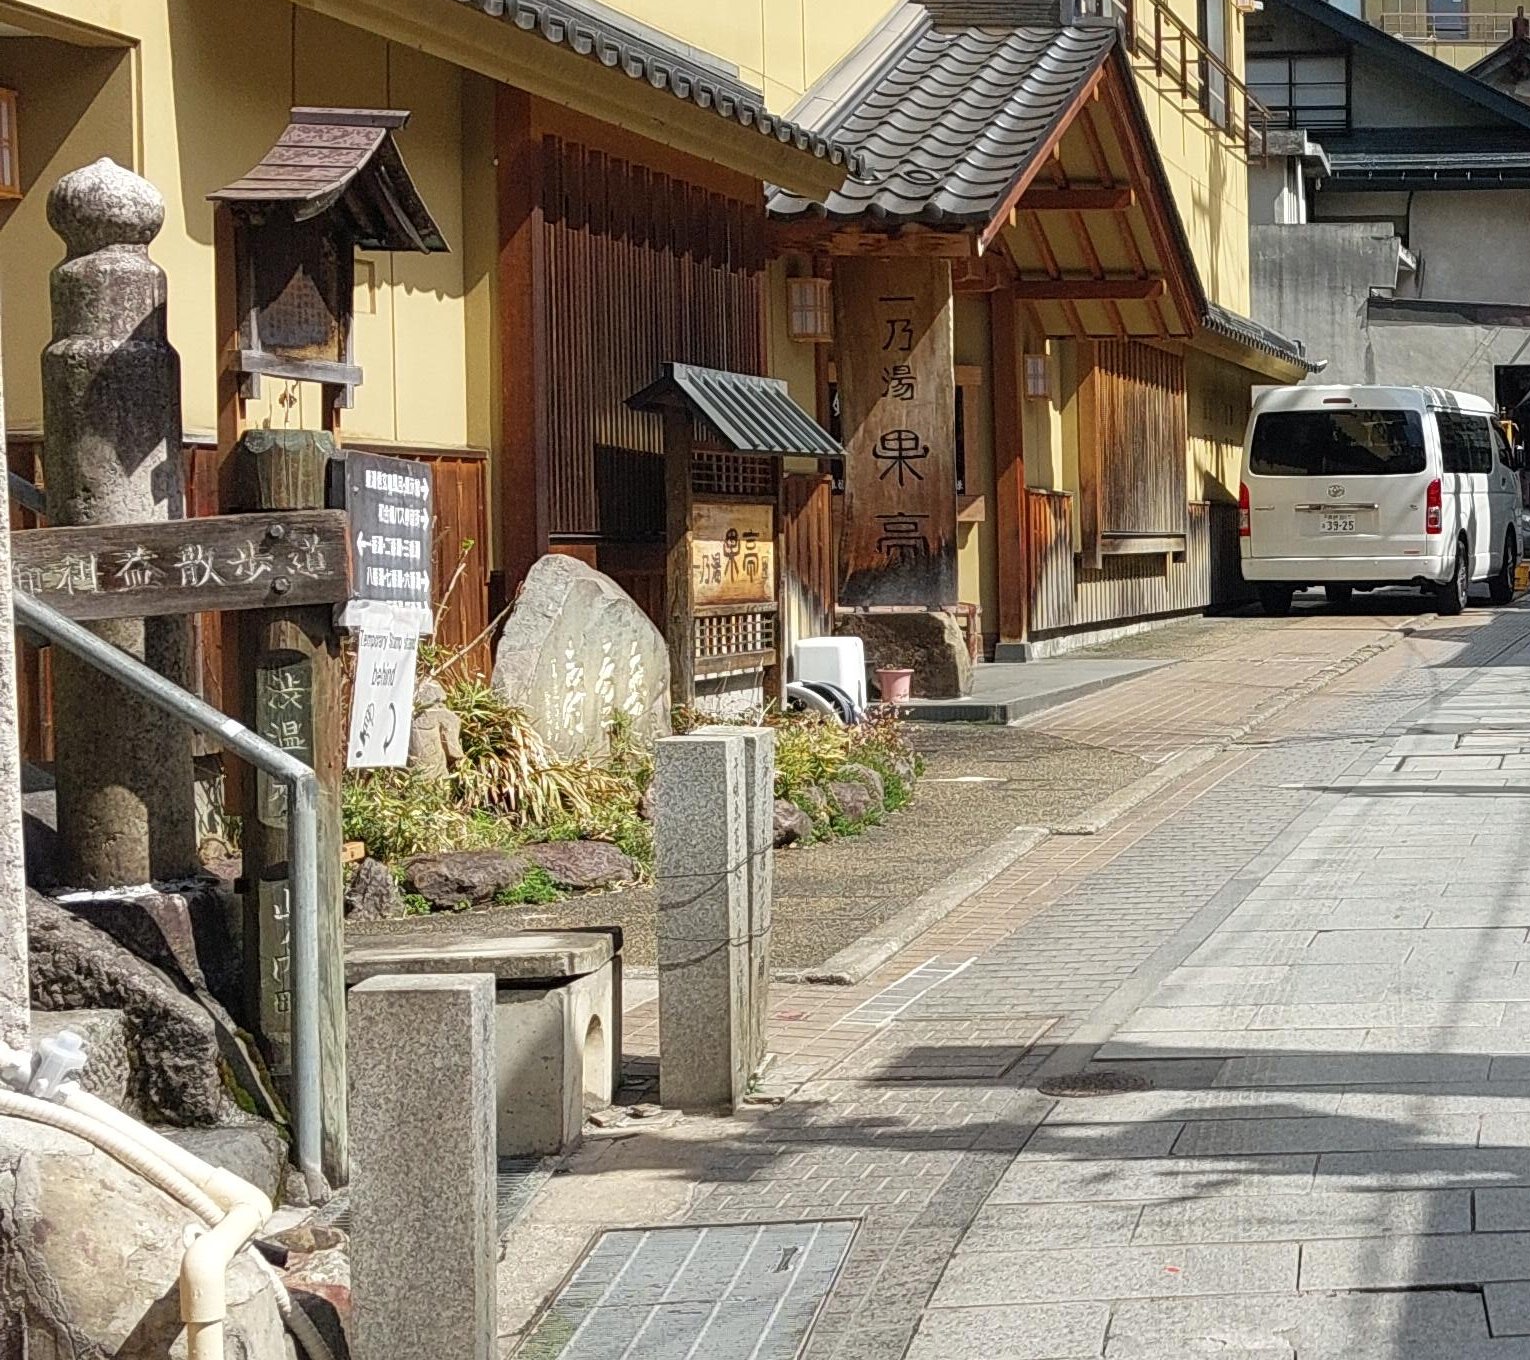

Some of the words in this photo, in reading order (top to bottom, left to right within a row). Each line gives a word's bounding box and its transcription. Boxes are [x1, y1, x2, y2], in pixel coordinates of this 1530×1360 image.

[872, 296, 930, 561] 一乃湯果亭
[266, 672, 307, 804] 渋温
[371, 662, 397, 687] behind
